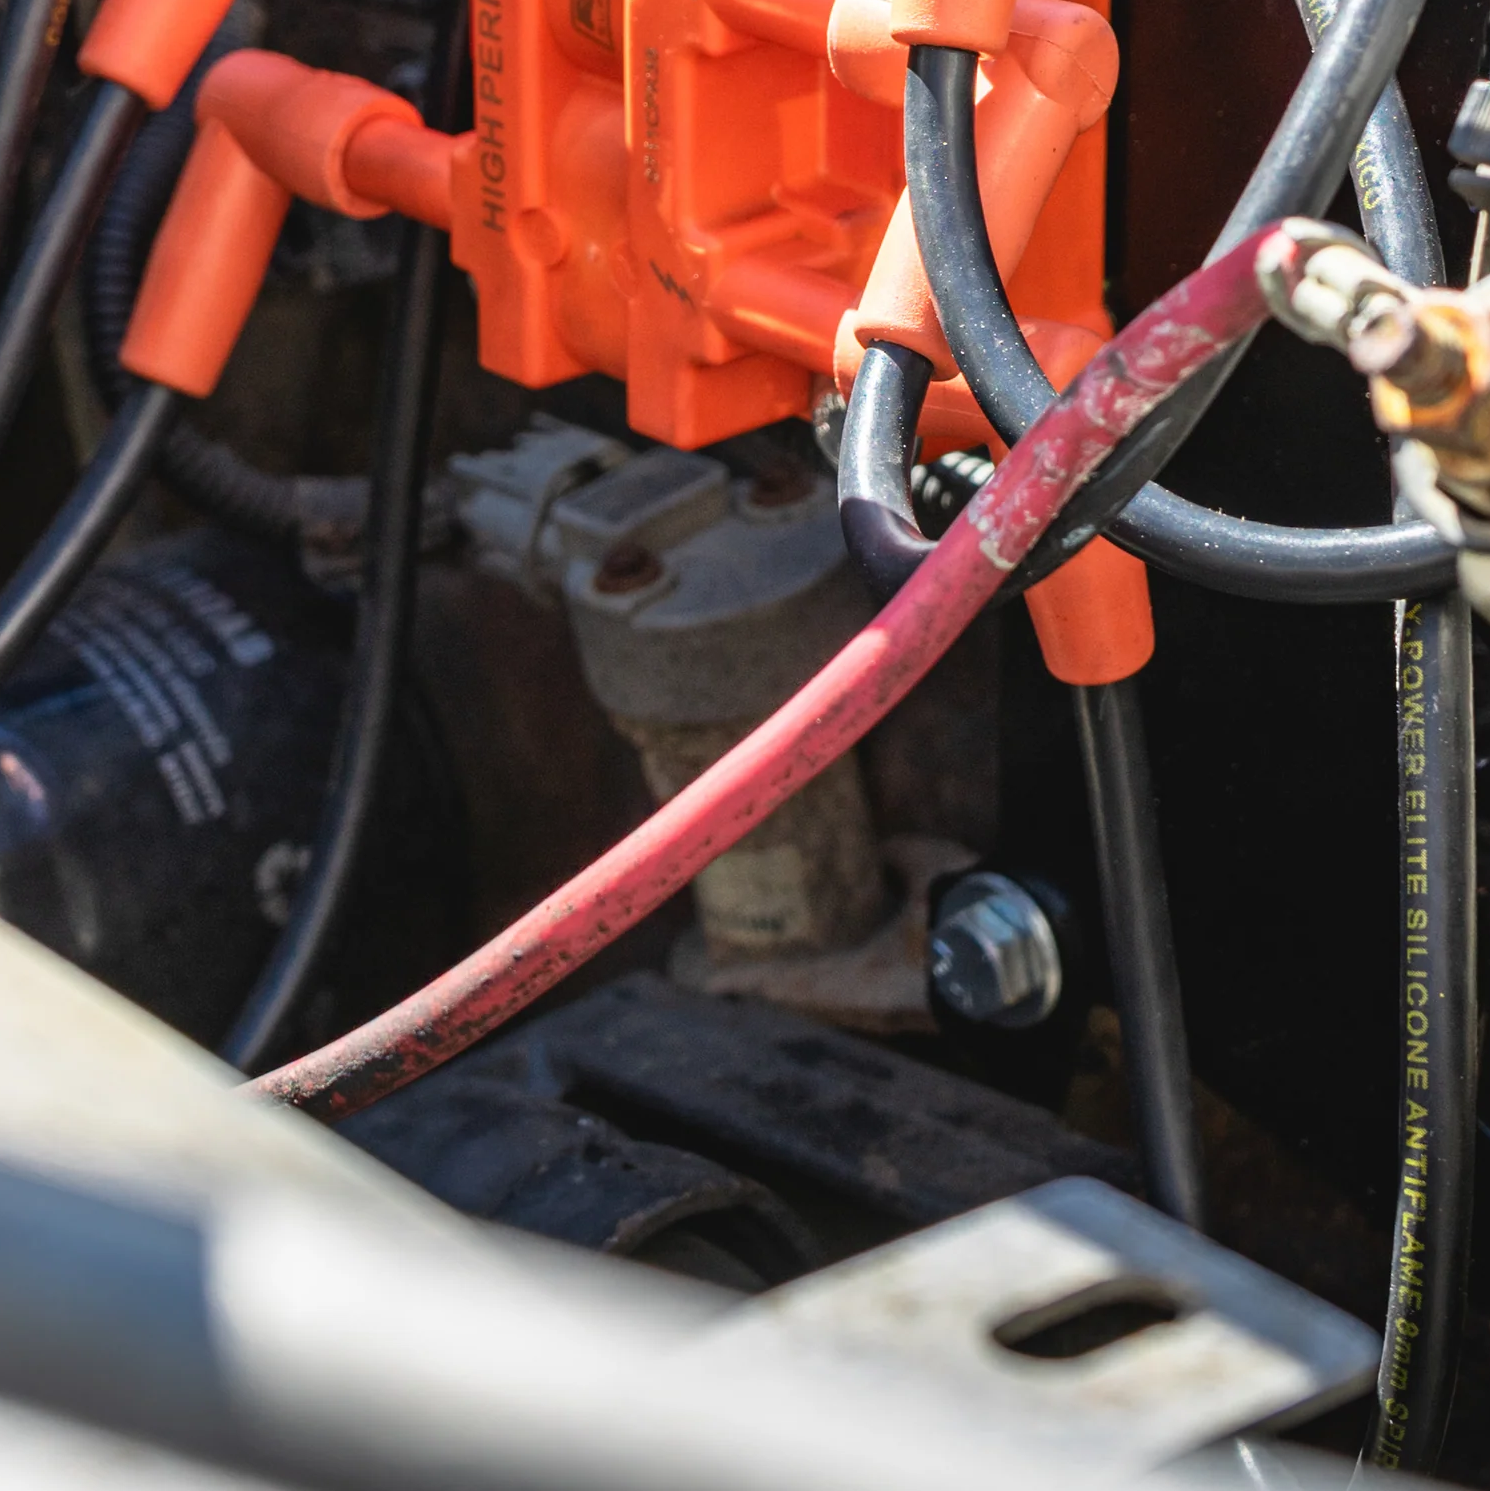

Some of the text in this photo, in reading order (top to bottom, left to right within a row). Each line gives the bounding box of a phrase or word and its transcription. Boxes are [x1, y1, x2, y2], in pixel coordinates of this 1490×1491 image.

[479, 114, 506, 234] HIGH
[1405, 789, 1428, 895] ELITE
[1405, 908, 1429, 1091] SILICONE
[1398, 1098, 1428, 1311] ANTIFLAME
[1389, 1316, 1419, 1391] 8mm
